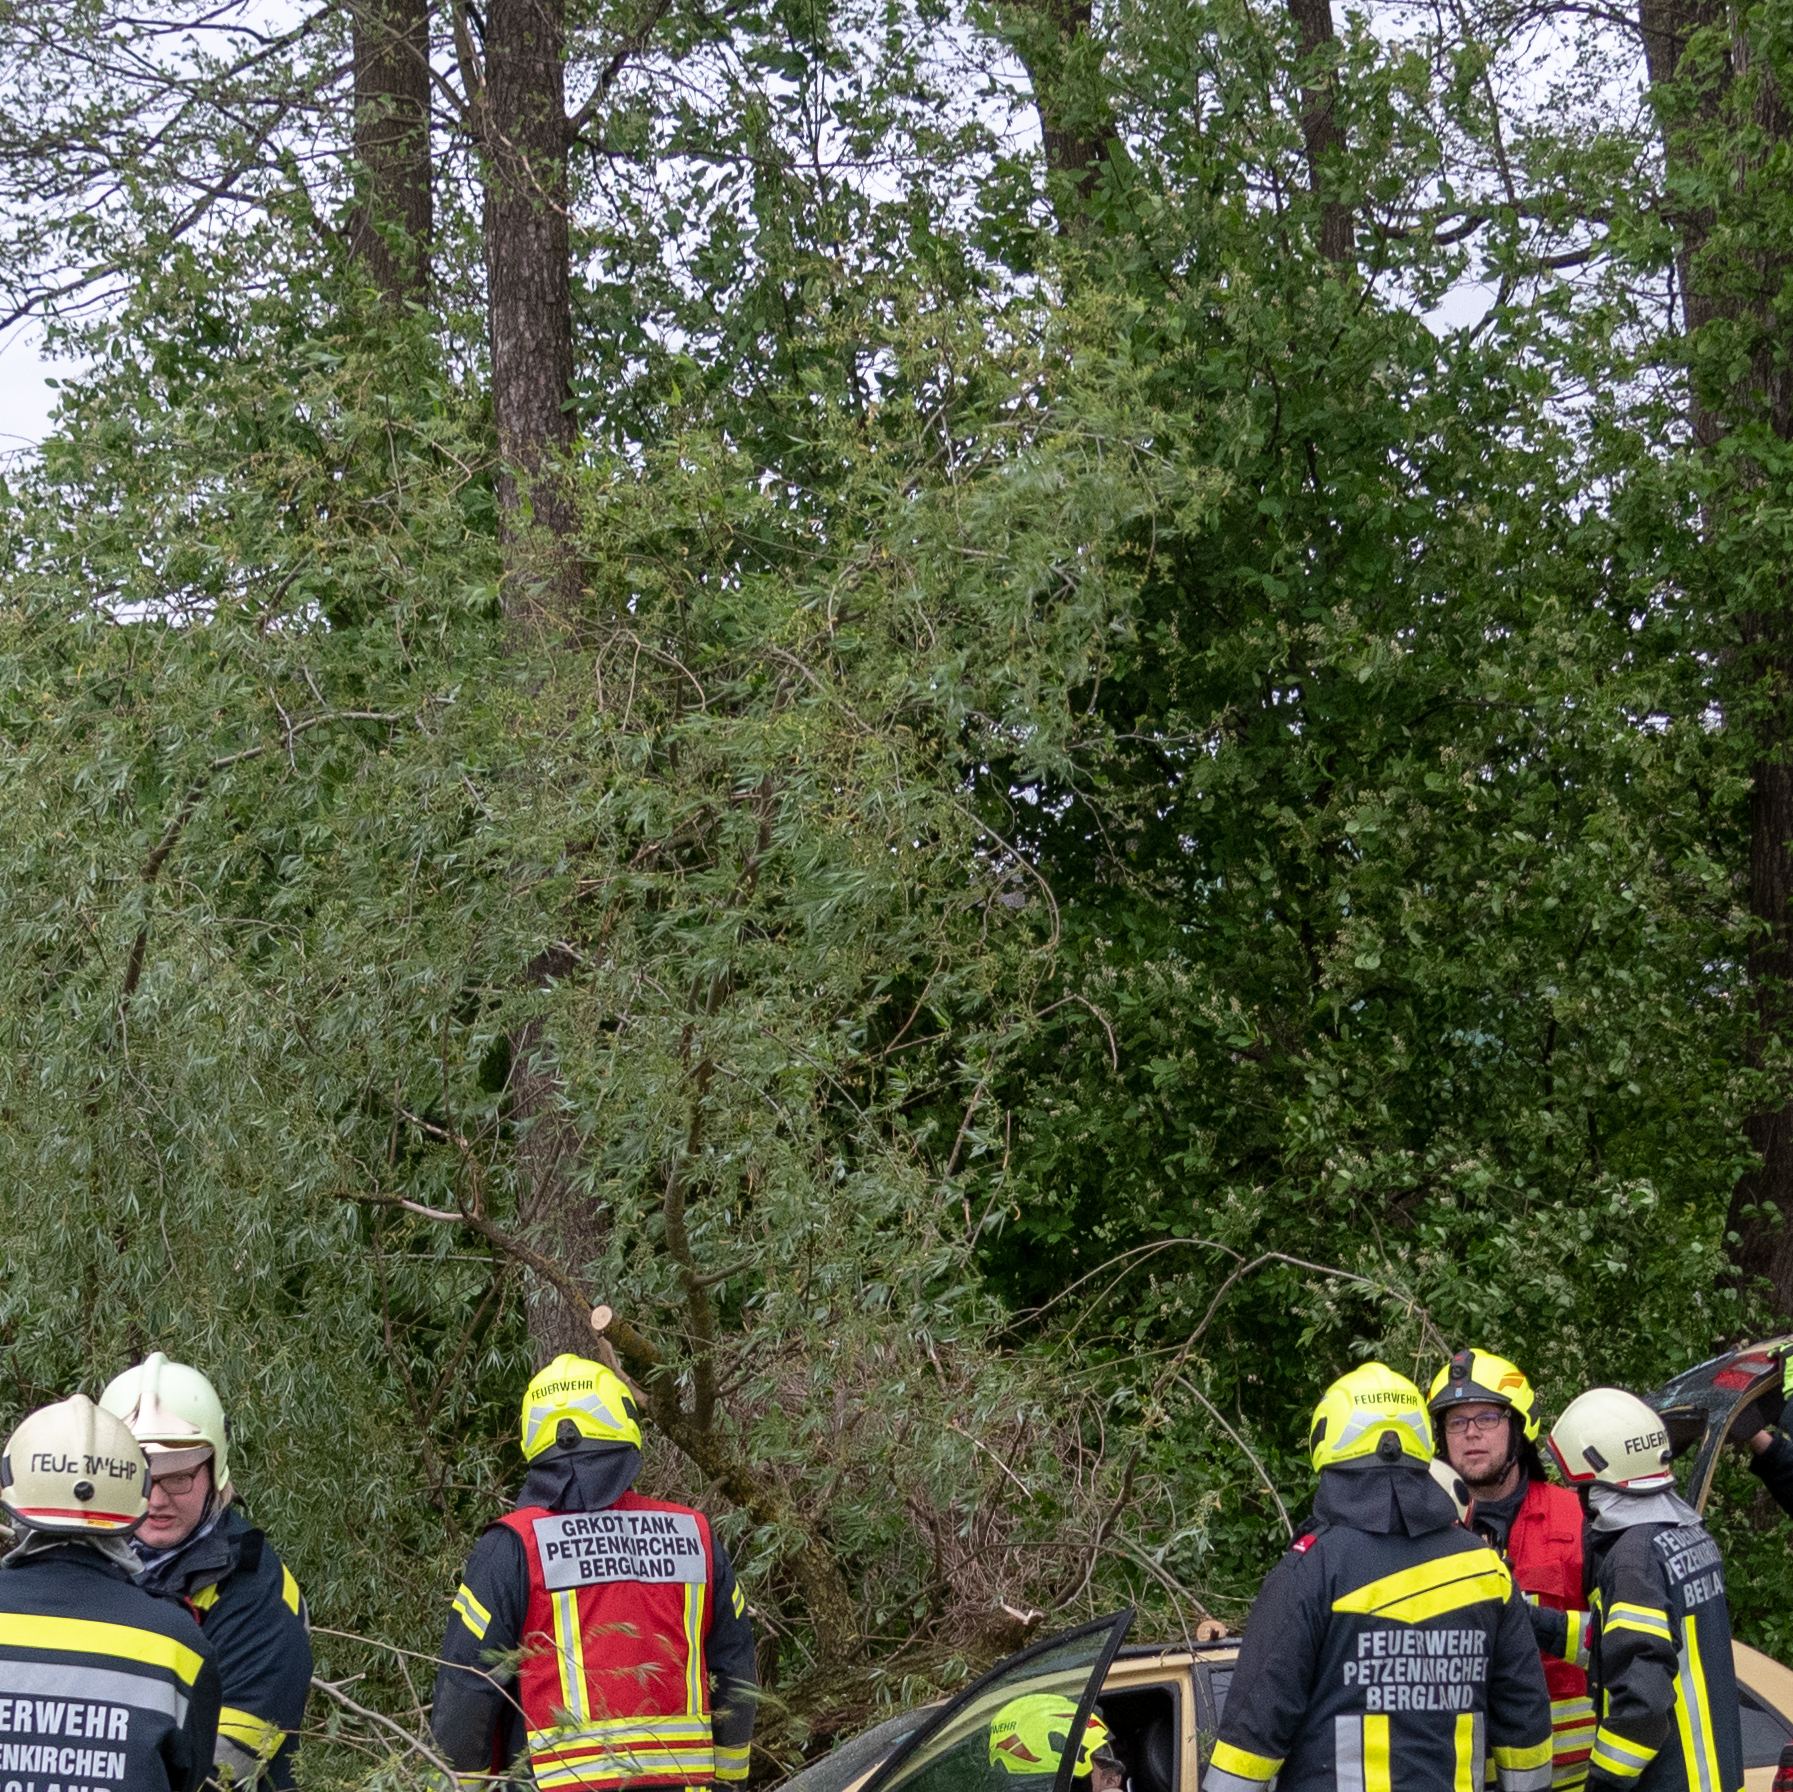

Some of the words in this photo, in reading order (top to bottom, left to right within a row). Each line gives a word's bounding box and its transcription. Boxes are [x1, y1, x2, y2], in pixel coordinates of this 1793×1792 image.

[531, 1380, 593, 1401] FEUERWEHR
[1354, 1392, 1418, 1406] FEUERWEHR
[562, 1515, 624, 1537] GRKDT
[628, 1516, 679, 1535] TANK
[546, 1536, 700, 1561] PETZENKIRCHEN
[579, 1557, 676, 1579] BERGLAND
[1358, 1629, 1486, 1658] FEUERWEHR
[1366, 1684, 1474, 1711] BERGLAND
